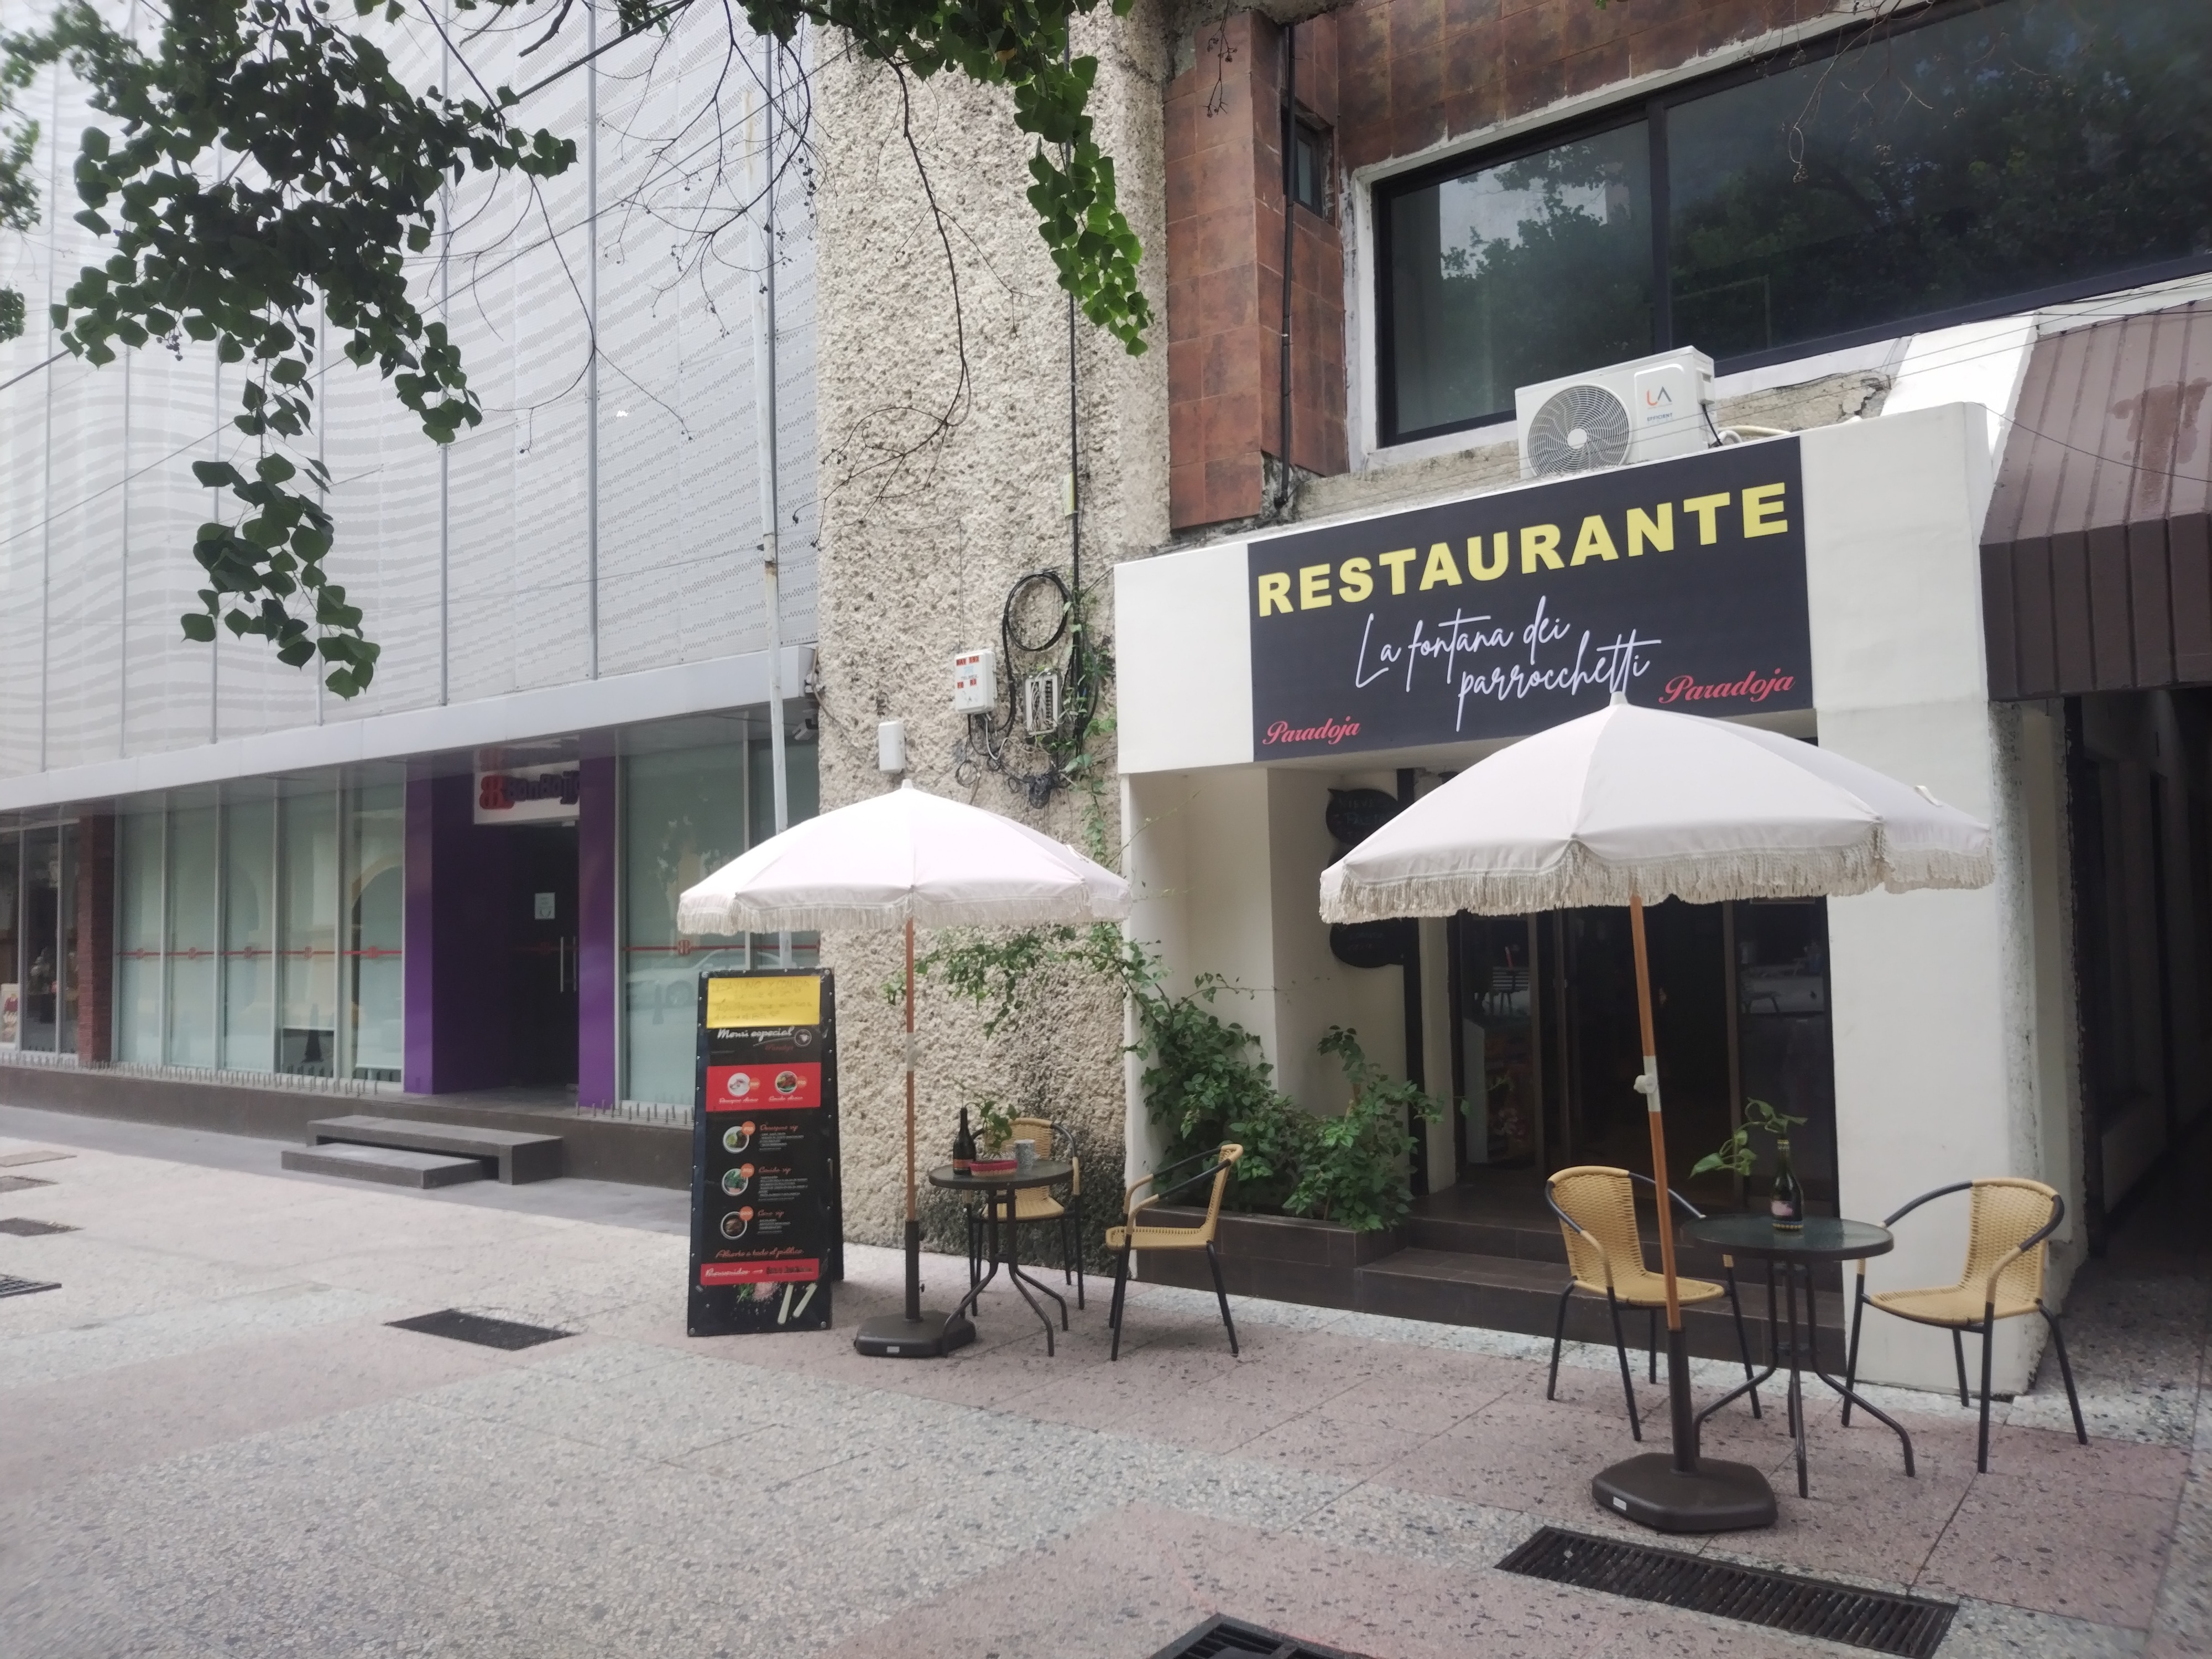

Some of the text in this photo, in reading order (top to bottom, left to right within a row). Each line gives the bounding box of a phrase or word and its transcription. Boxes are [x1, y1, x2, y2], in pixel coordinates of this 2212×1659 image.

[1258, 482, 1788, 617] RESTAURANTE
[1355, 595, 1571, 693] La fontana dei
[1455, 629, 1662, 732] parrocchetti
[1658, 667, 1796, 704] Paradoja
[1262, 716, 1361, 745] Paradoja
[750, 1026, 795, 1042] especial
